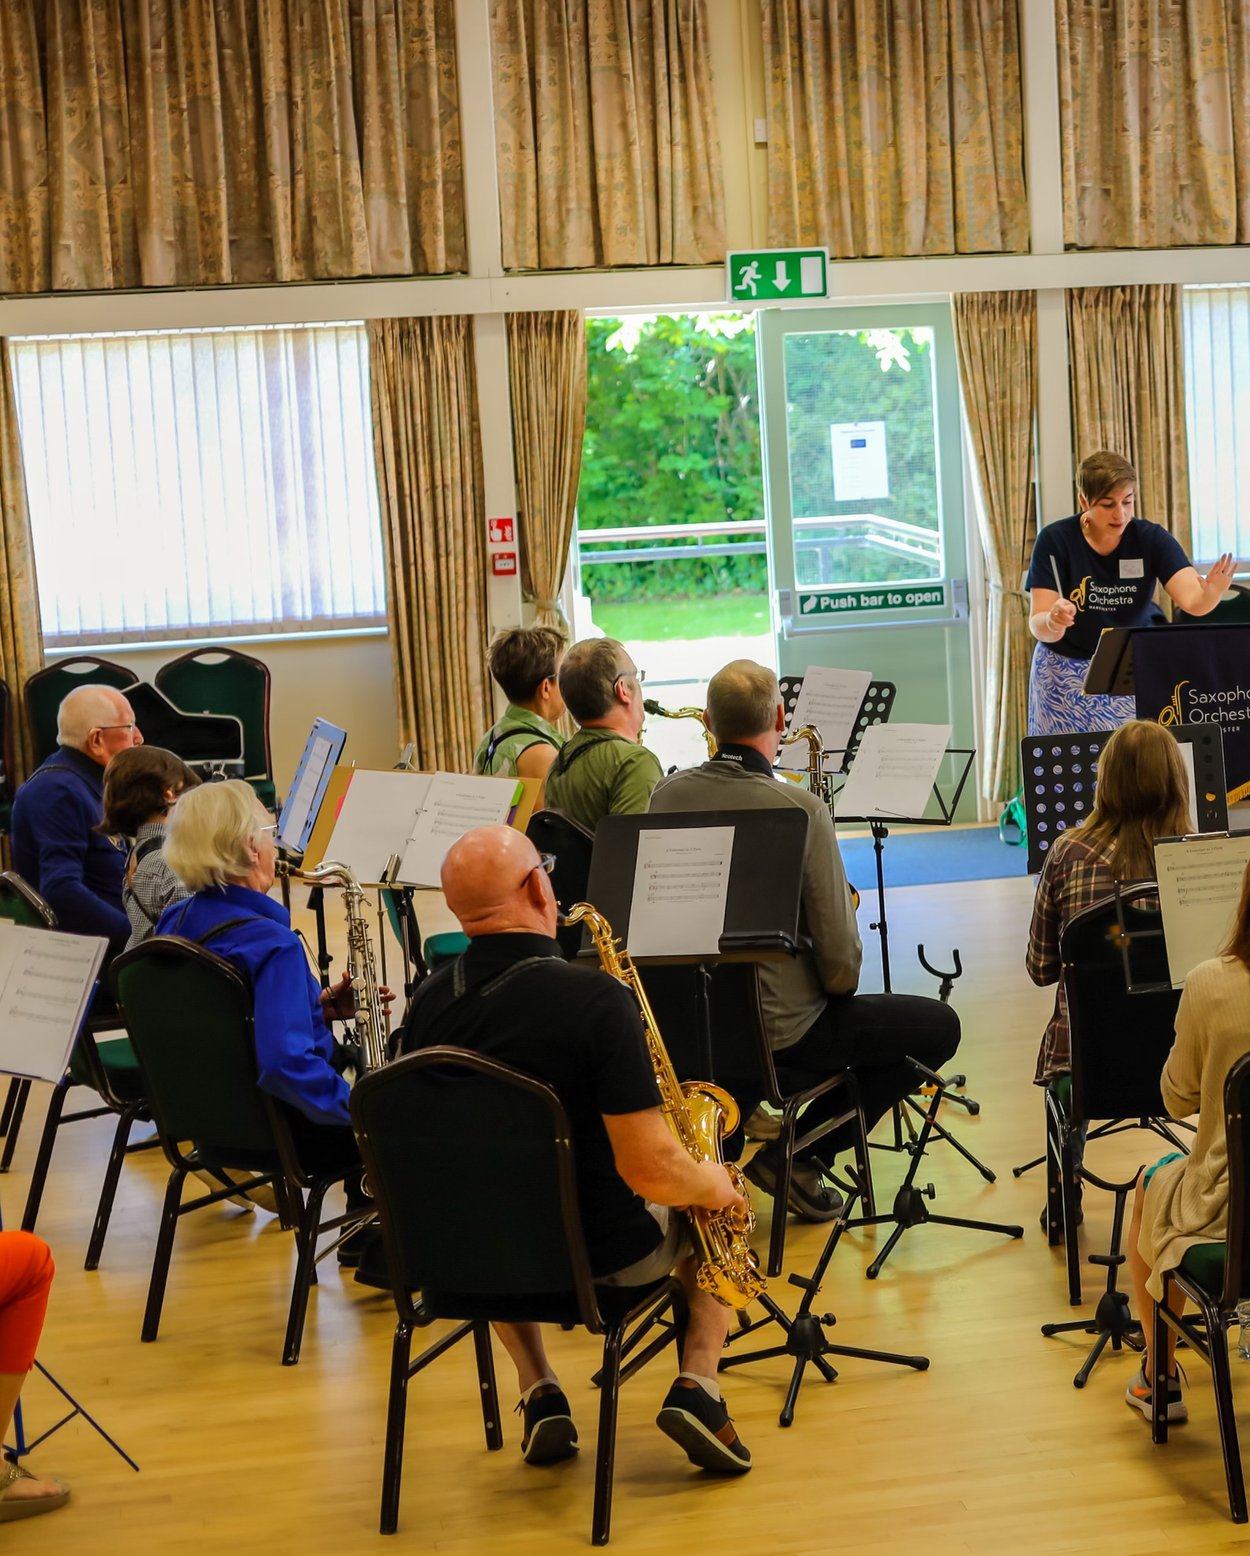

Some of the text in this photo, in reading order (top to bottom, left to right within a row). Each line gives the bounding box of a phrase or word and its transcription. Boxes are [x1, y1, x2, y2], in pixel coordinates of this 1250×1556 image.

[820, 591, 941, 610] Push bar to open
